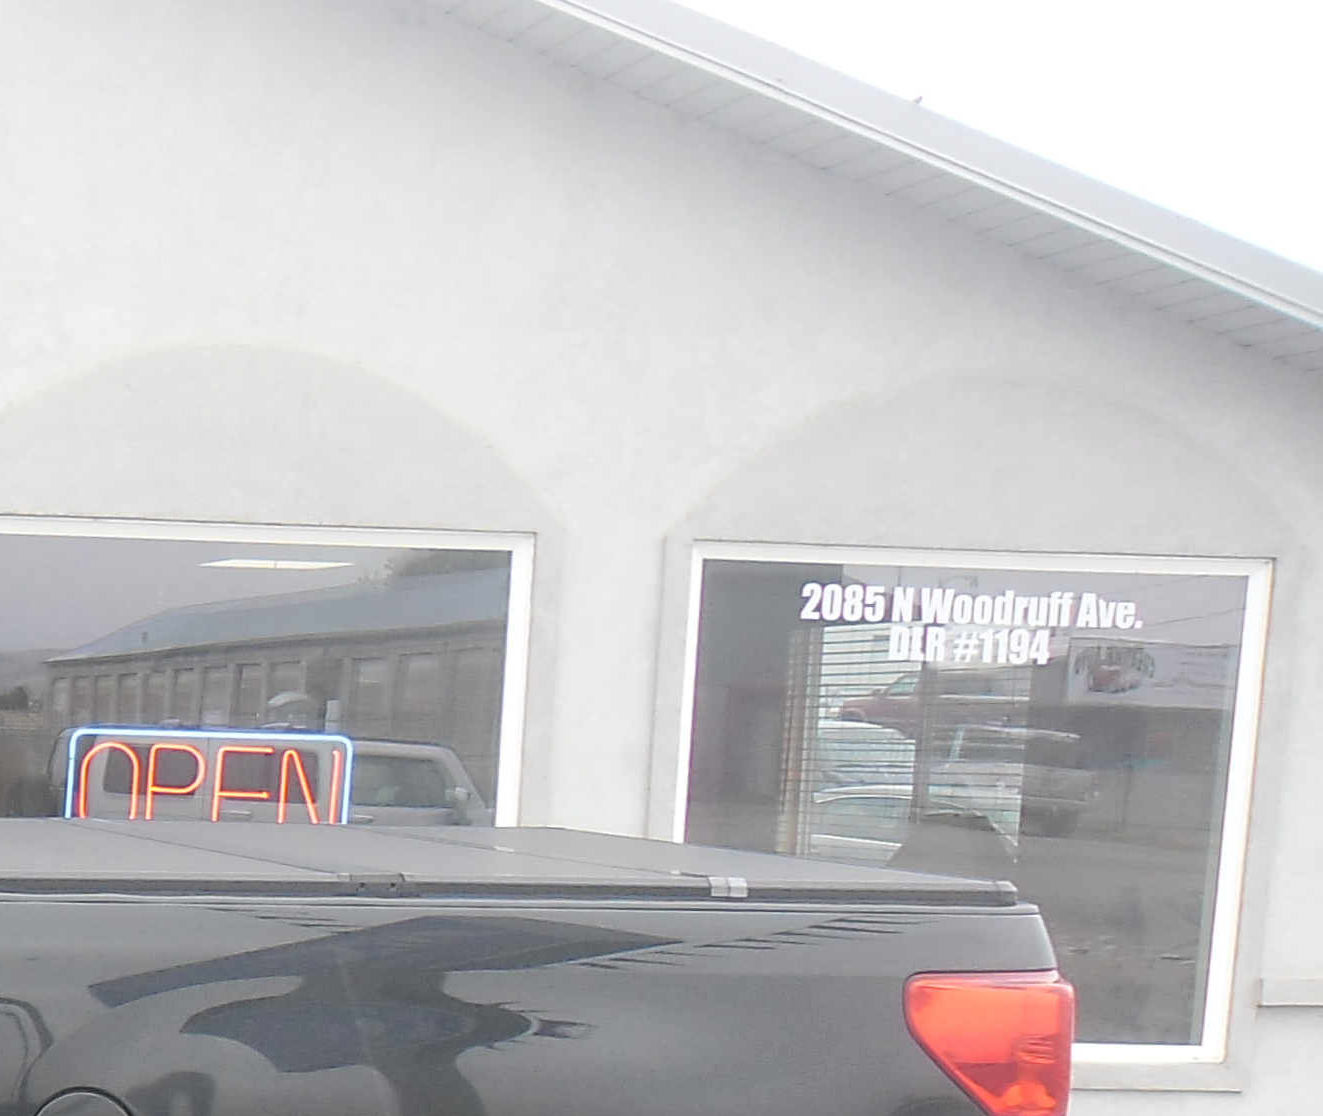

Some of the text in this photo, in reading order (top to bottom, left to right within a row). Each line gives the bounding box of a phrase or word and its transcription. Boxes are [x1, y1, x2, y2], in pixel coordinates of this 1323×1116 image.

[800, 582, 1144, 630] 2085 N Woodruff Ave.
[888, 625, 1051, 666] DLR #1194
[77, 740, 342, 825] OPEN
